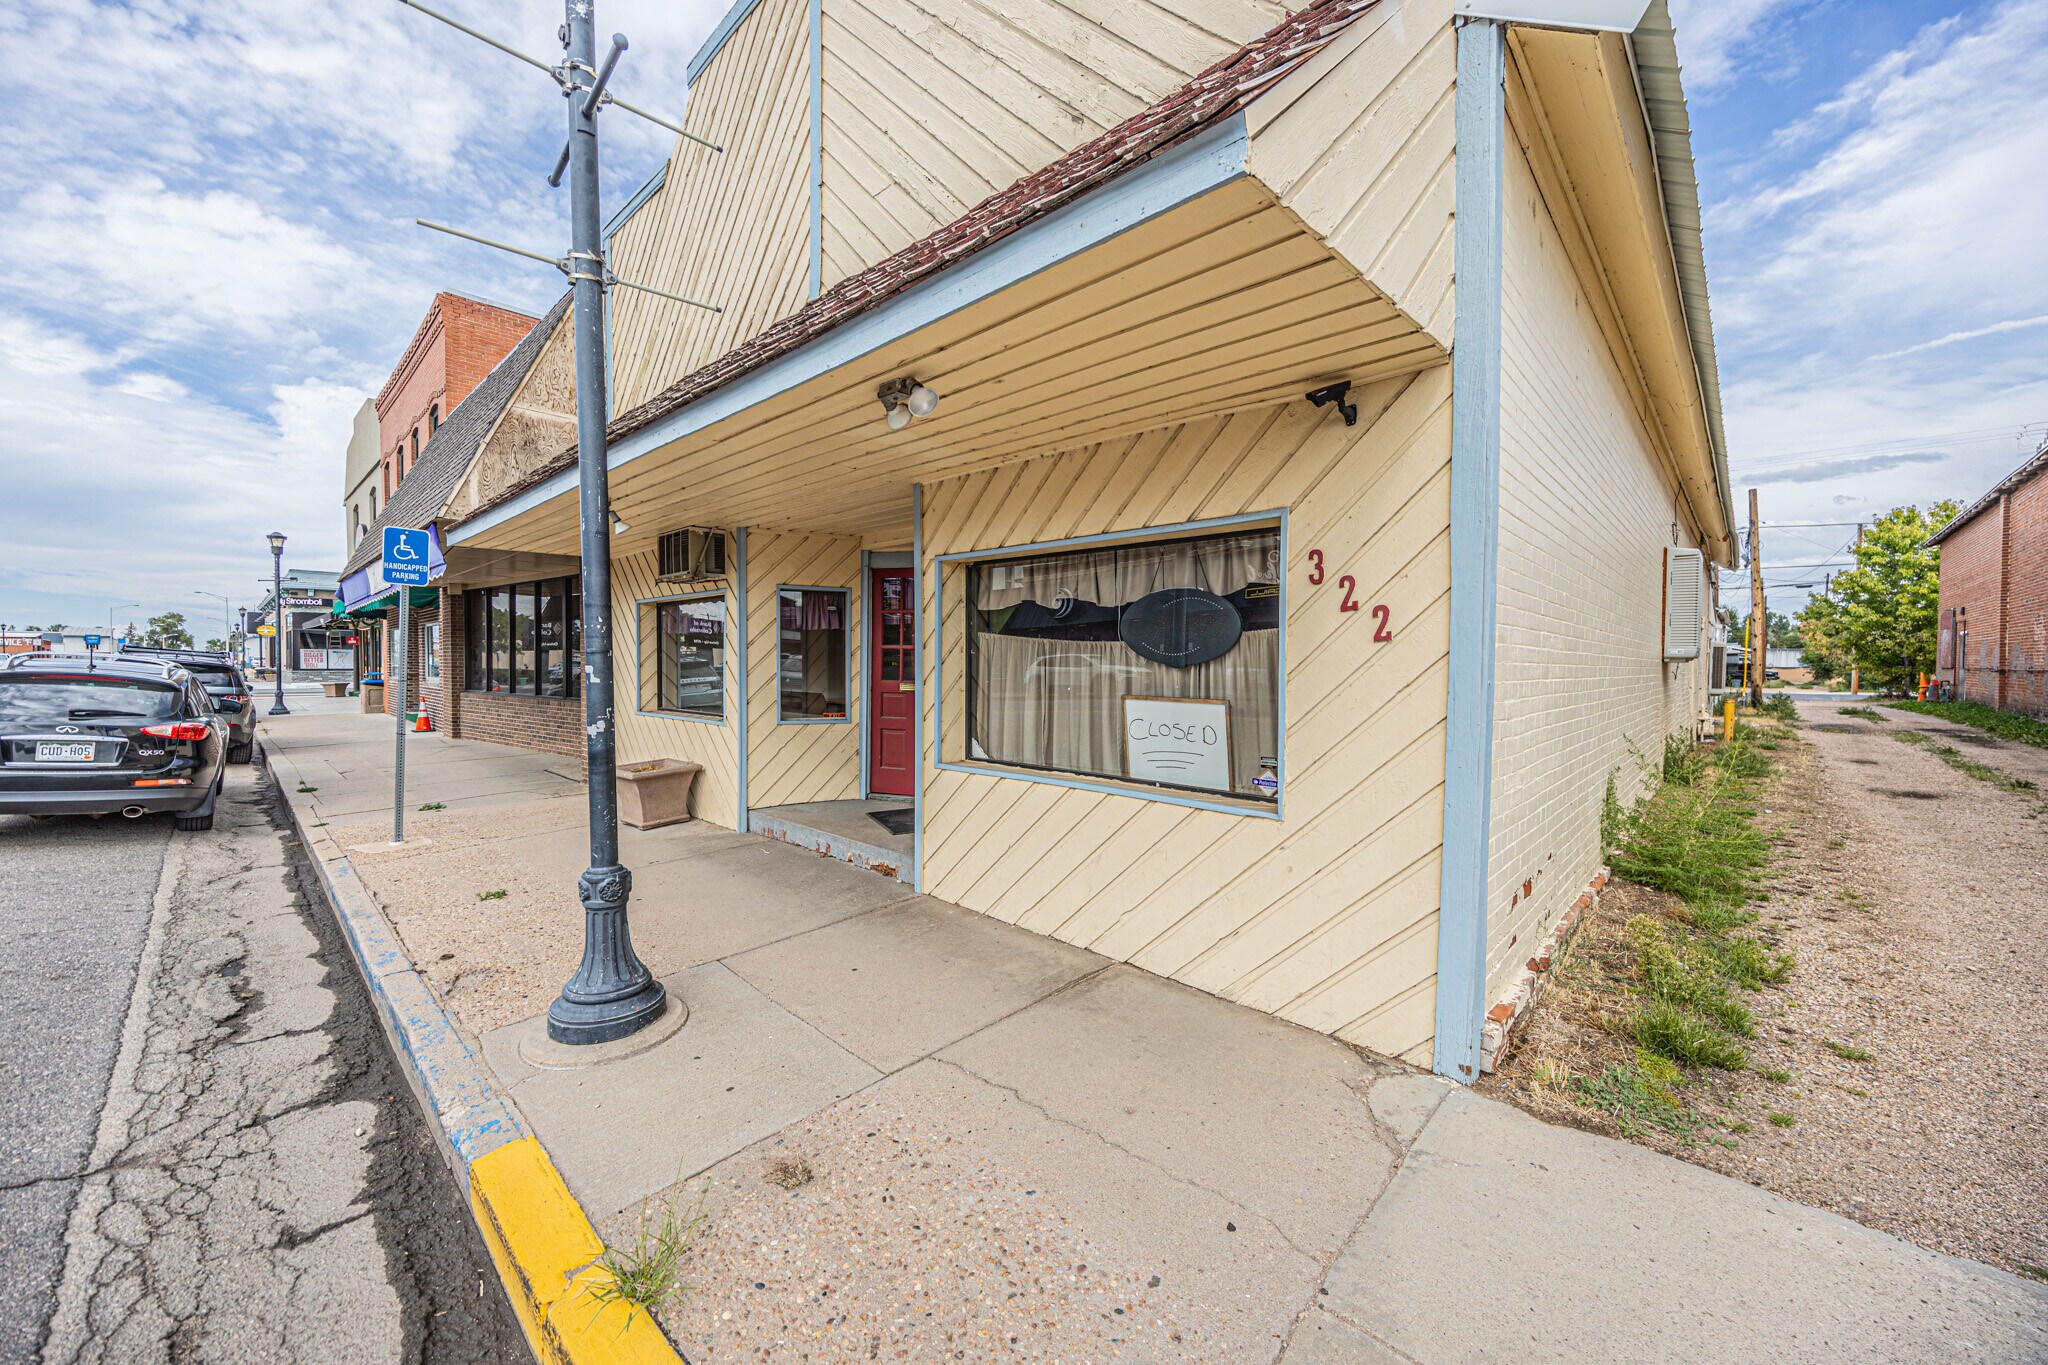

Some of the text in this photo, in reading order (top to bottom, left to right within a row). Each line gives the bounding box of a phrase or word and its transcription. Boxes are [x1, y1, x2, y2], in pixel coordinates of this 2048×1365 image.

[384, 562, 428, 572] HANDICAPPED
[391, 571, 420, 580] PARKING
[1308, 549, 1393, 643] 322
[286, 597, 323, 606] Stromboli
[1129, 718, 1218, 746] CLOSED
